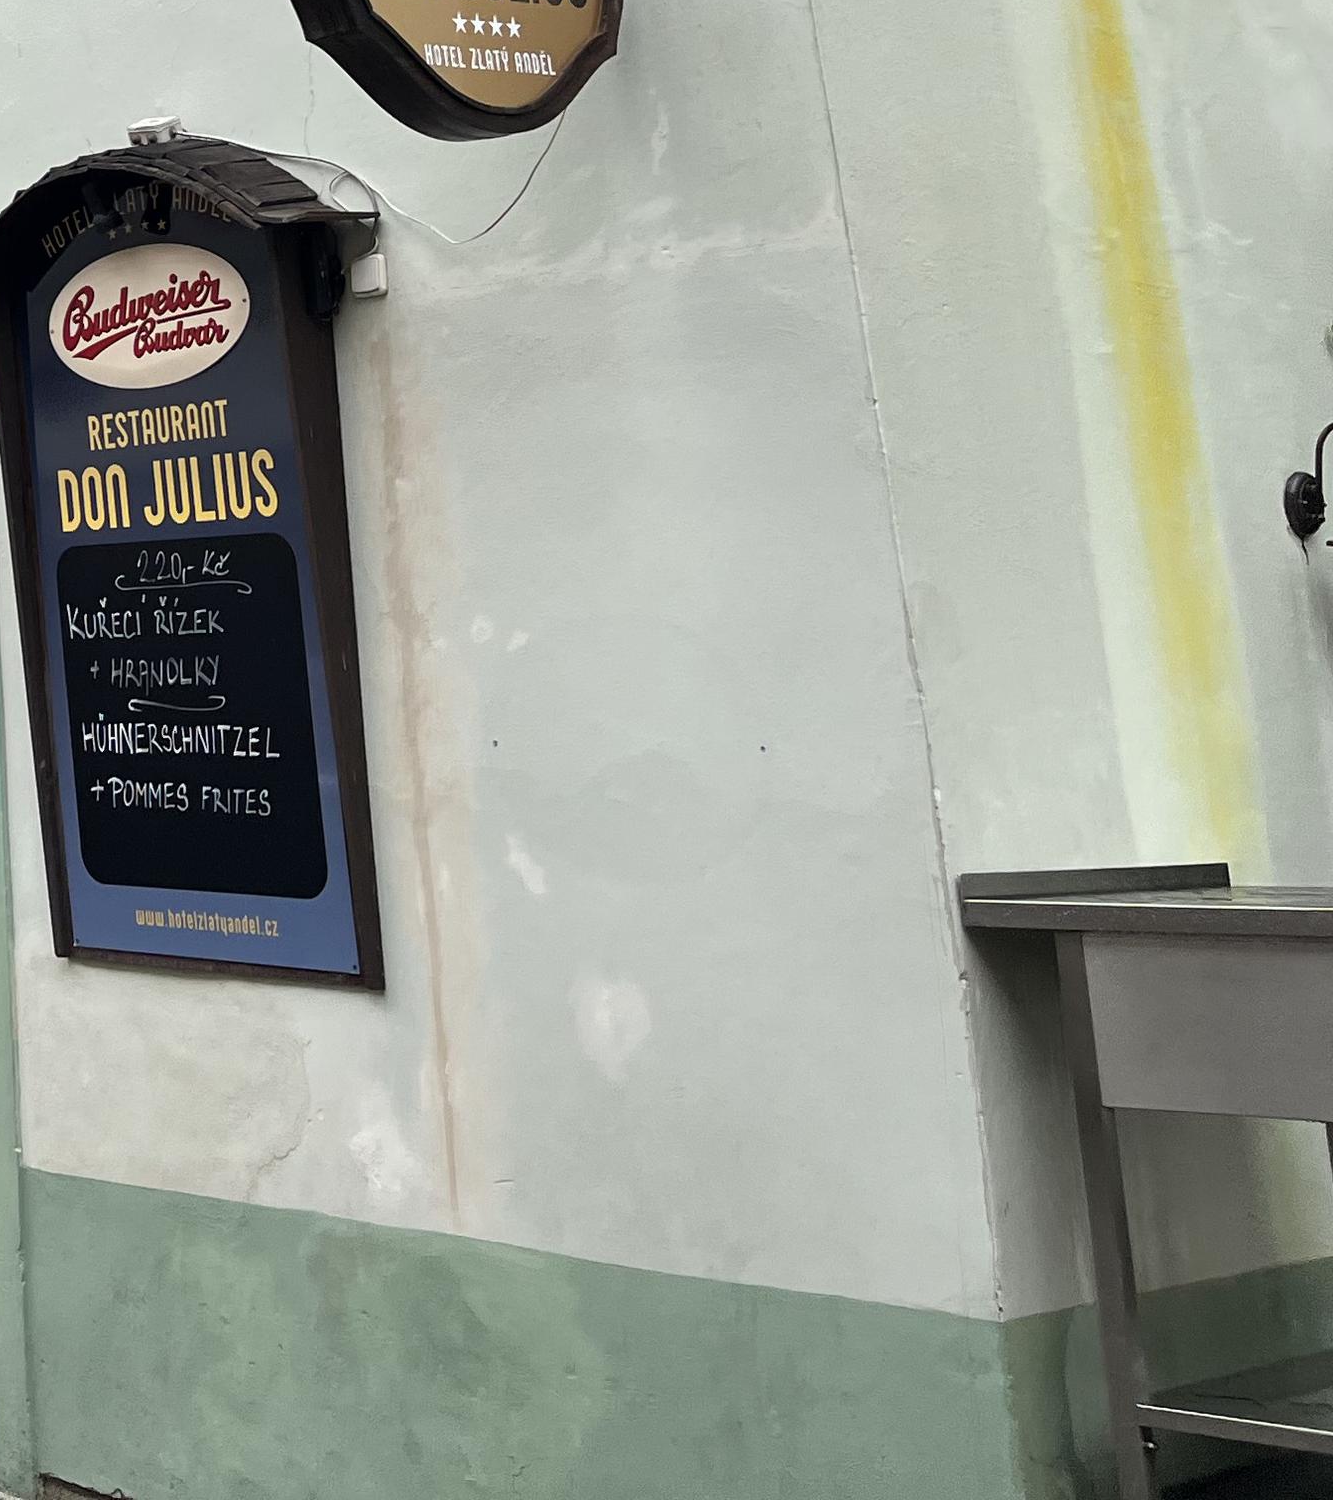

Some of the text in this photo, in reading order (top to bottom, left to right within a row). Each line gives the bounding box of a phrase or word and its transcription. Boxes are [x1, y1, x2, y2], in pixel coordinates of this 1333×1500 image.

[423, 43, 467, 69] HOTEL
[469, 46, 509, 72] ZLATÝ
[41, 205, 96, 259] HOTEL
[63, 270, 232, 351] Budweiser
[133, 317, 230, 359] Budvar
[87, 398, 228, 452] RESTAURANT
[57, 448, 279, 533] DON JULIUS
[202, 550, 231, 576] Kč
[66, 594, 225, 640] KUŘECÍ ŘÍZEK
[111, 655, 220, 696] HRANOLKY
[82, 712, 280, 758] HÜHNERSCHNITZEL
[201, 786, 272, 817] FRITES
[135, 909, 279, 937] www.hotelzlatyandel.cz
